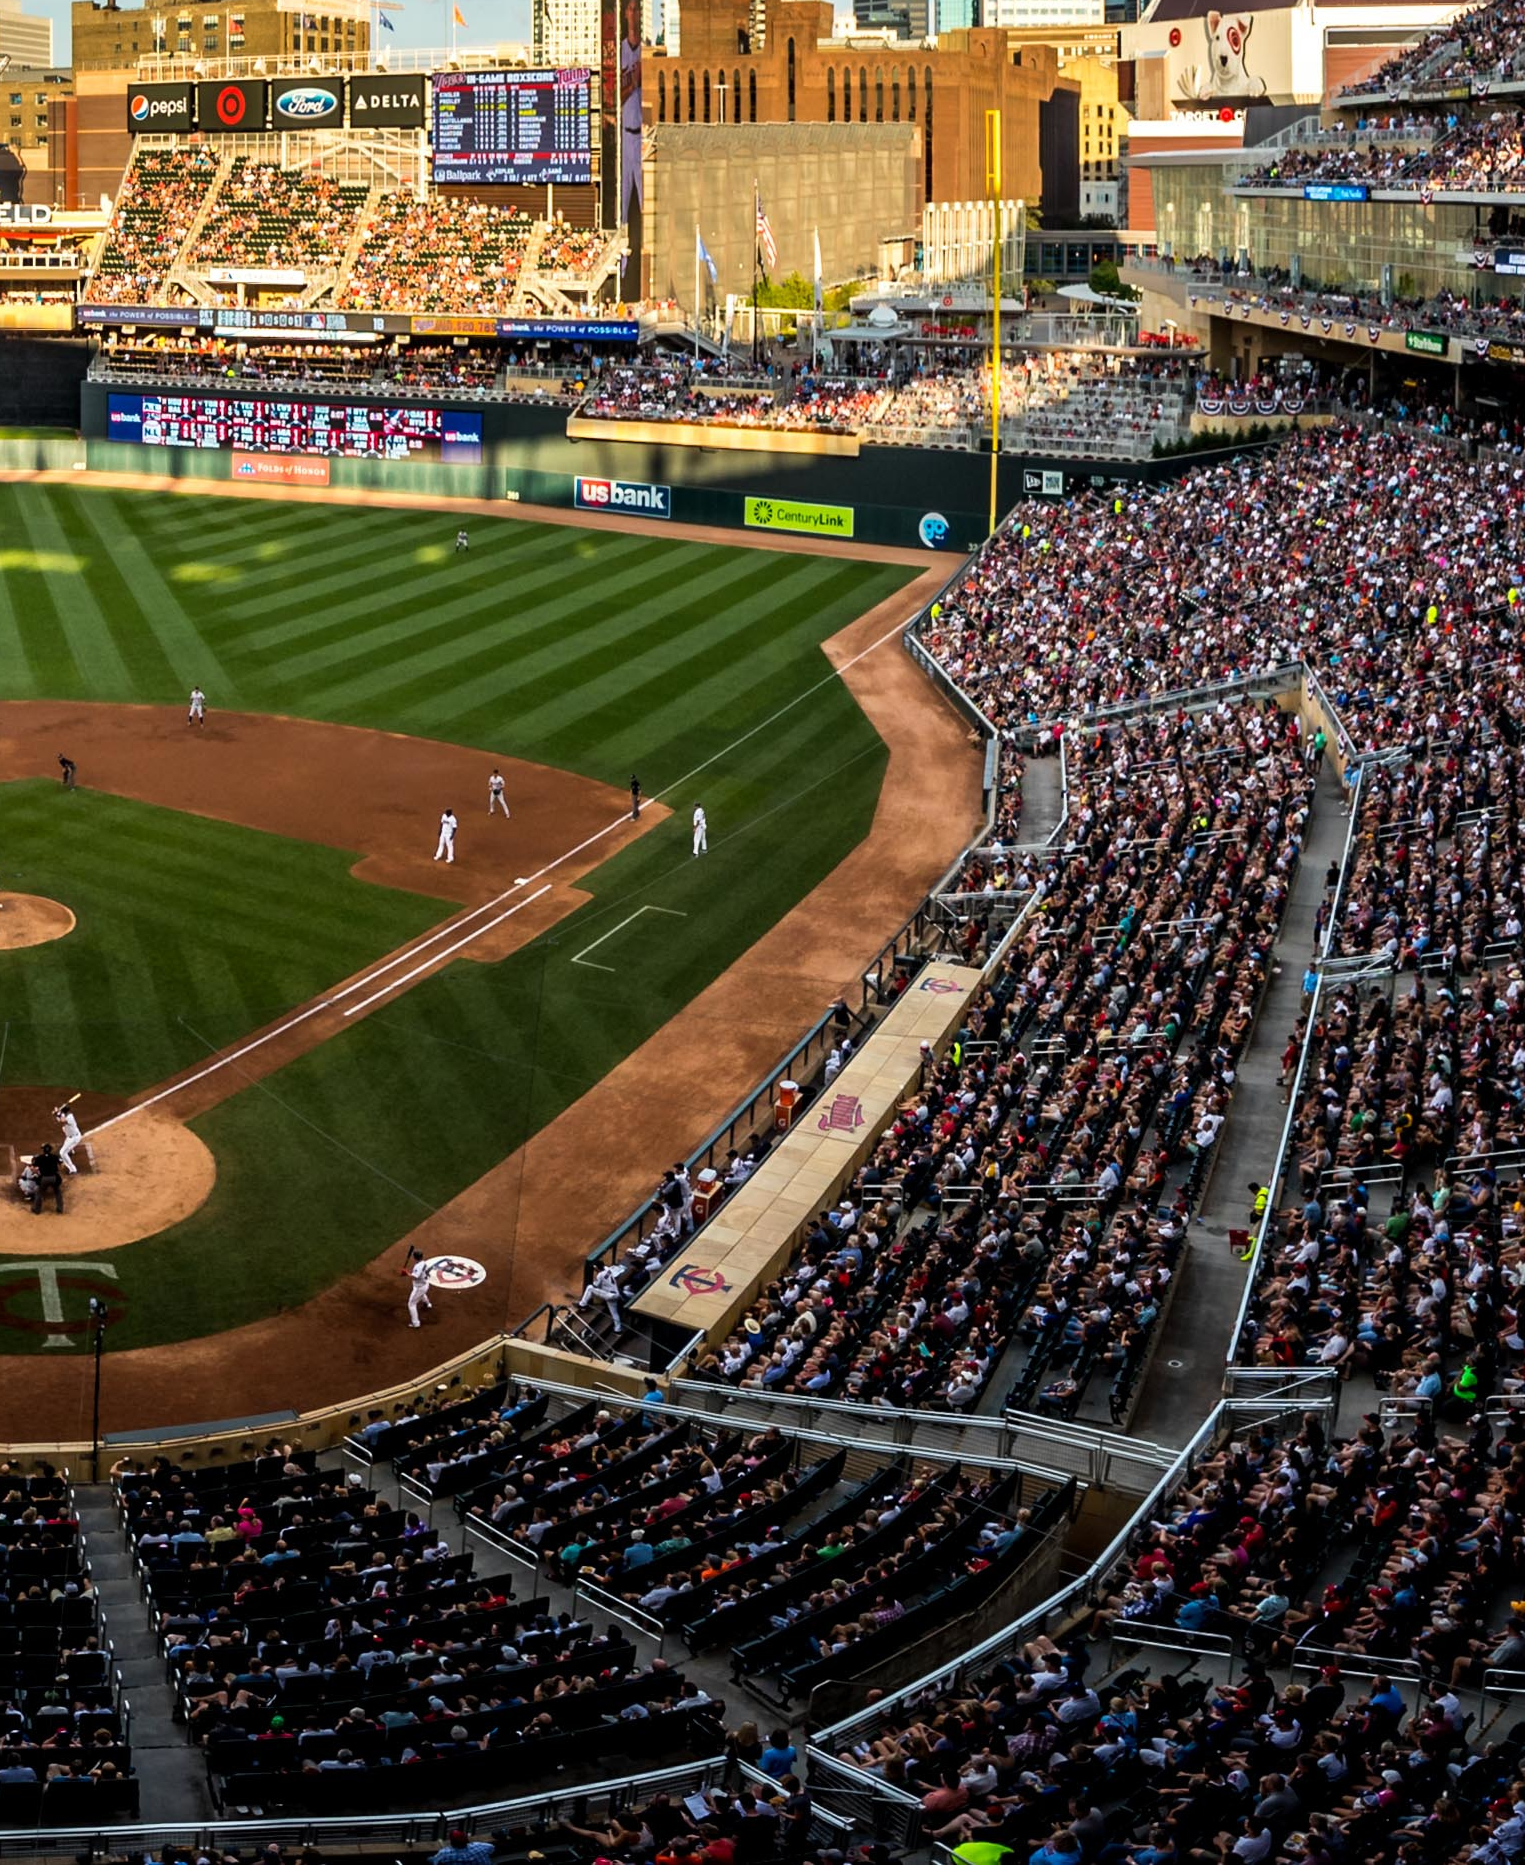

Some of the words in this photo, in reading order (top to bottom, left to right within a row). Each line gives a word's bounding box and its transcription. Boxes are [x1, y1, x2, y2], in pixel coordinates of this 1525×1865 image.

[467, 74, 505, 84] IN-GAME
[507, 72, 554, 82] BOXSCORE
[554, 68, 590, 84] Twins
[150, 96, 187, 117] pepsi
[288, 93, 325, 113] Ford
[370, 94, 419, 109] DELTA
[1169, 110, 1219, 122] TARGET
[446, 170, 481, 181] Ballpark
[120, 312, 146, 320] POWER
[546, 325, 576, 333] POWER
[588, 326, 632, 334] POSSIBLE.
[258, 463, 284, 472] FOLDS
[294, 466, 325, 476] HONOR
[777, 508, 845, 527] CenturyLink
[923, 517, 946, 540] go
